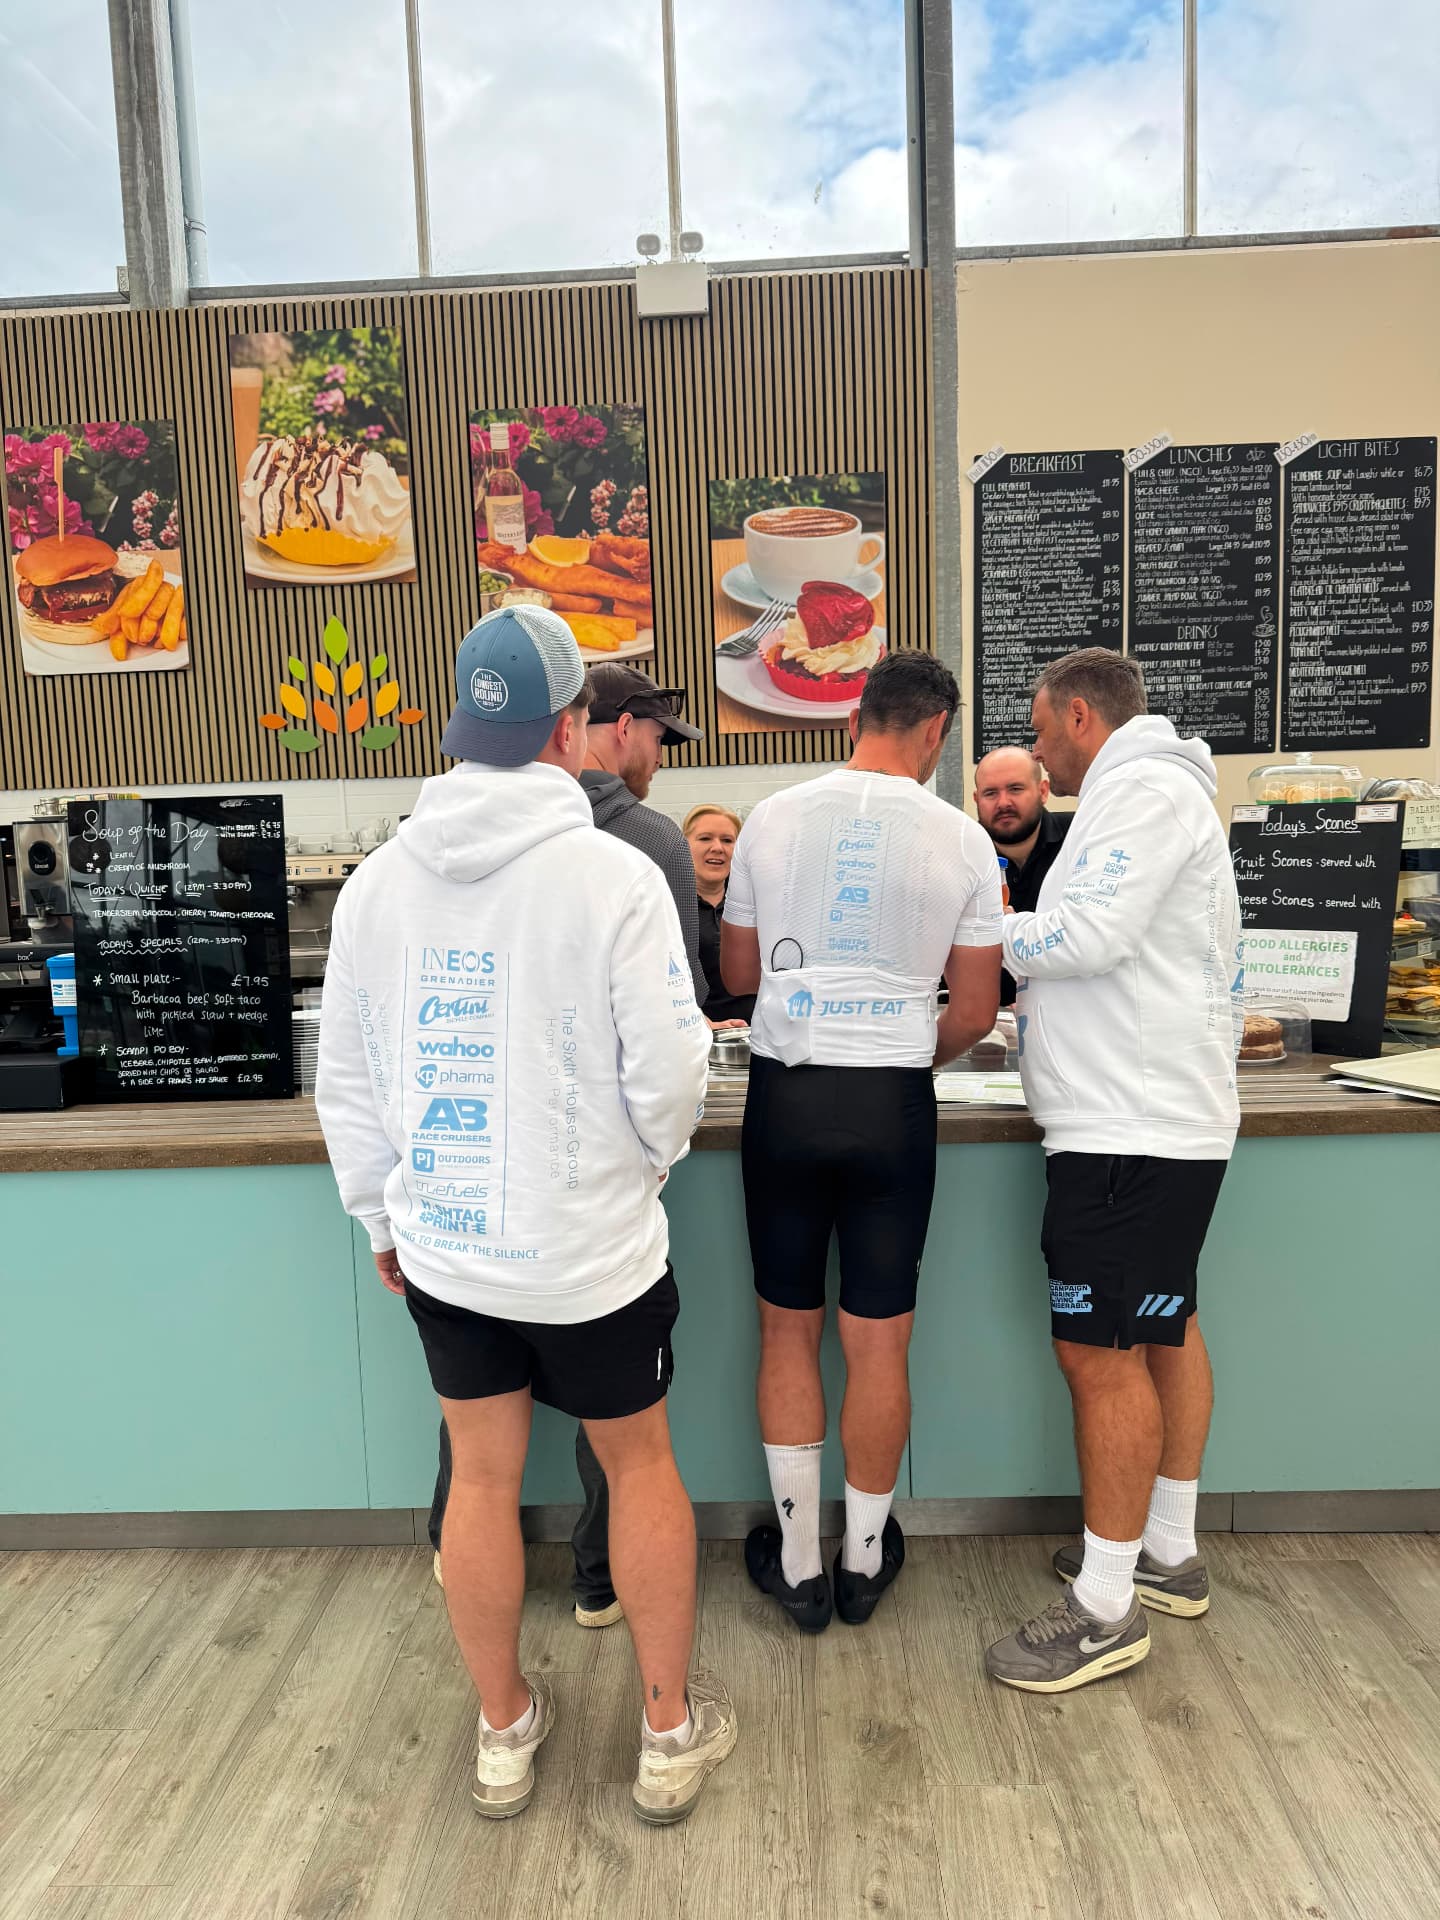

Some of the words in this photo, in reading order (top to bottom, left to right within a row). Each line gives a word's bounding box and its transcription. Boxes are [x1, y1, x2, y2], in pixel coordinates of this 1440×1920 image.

[1170, 447, 1234, 465] LUNCHES
[1318, 442, 1360, 458] LIGHT
[1365, 441, 1400, 457] BITES
[1010, 454, 1086, 473] BREAKFAST
[1178, 625, 1218, 640] DRINKS
[475, 678, 502, 691] LONGEST
[481, 673, 492, 681] THE
[475, 688, 503, 702] ROUND
[83, 809, 123, 845] Soup
[128, 826, 145, 844] of
[144, 823, 166, 838] the
[171, 821, 209, 850] Day
[1261, 808, 1306, 837] Today's
[1315, 808, 1358, 830] Scones
[110, 852, 136, 860] LENTIL
[1233, 848, 1265, 868] Fruit
[1271, 850, 1312, 868] Scones
[1355, 854, 1376, 868] with
[108, 864, 135, 873] CREAM
[837, 859, 876, 869] wahoo
[1103, 867, 1126, 876] NAVY
[1105, 862, 1127, 871] ROYAL
[1236, 869, 1264, 880] butter
[837, 886, 869, 904] AB
[1206, 873, 1217, 918] Group
[1272, 888, 1315, 907] Scones
[1325, 894, 1356, 908] served
[1362, 897, 1381, 909] with
[93, 910, 139, 918] TENDERSTEM
[181, 910, 207, 918] CHERRY
[242, 911, 276, 920] CHEDDAR
[140, 938, 182, 947] SPECIALS
[1045, 927, 1066, 950] EAT
[1203, 921, 1217, 964] House
[1243, 939, 1276, 949] FOOD
[1280, 940, 1348, 953] ALLERGIES
[422, 947, 495, 973] INEOS
[1283, 953, 1302, 961] and
[1245, 963, 1340, 978] INTOLERANCES
[110, 973, 139, 985] Small
[231, 975, 269, 987] £7.95
[420, 975, 495, 987] GRENADIER
[131, 990, 181, 1005] Barbacoa
[187, 993, 210, 1006] beef
[237, 995, 261, 1005] taco
[358, 988, 374, 1035] Group
[820, 1000, 868, 1016] JUST
[871, 1001, 906, 1015] EAT
[162, 1009, 195, 1024] pickled
[237, 1010, 268, 1023] wedge
[561, 1004, 577, 1035] The
[116, 1046, 148, 1056] SCAMPI
[154, 1046, 166, 1054] PO
[417, 1036, 495, 1058] wahoo
[158, 1058, 192, 1066] CHIPOTLE
[562, 1040, 577, 1077] Sixth
[118, 1070, 142, 1078] SERVED
[160, 1068, 180, 1076] CHIPS
[196, 1066, 219, 1074] SALAD
[440, 1068, 495, 1086] pharma
[157, 1077, 165, 1085] OF
[418, 1097, 488, 1132] AB
[566, 1082, 580, 1136] House
[438, 1155, 491, 1164] OUTDOORS
[566, 1140, 580, 1190] Group
[419, 1234, 432, 1245] TO
[434, 1238, 470, 1254] BREAK
[472, 1243, 492, 1256] THE
[494, 1249, 539, 1259] SILENCE
